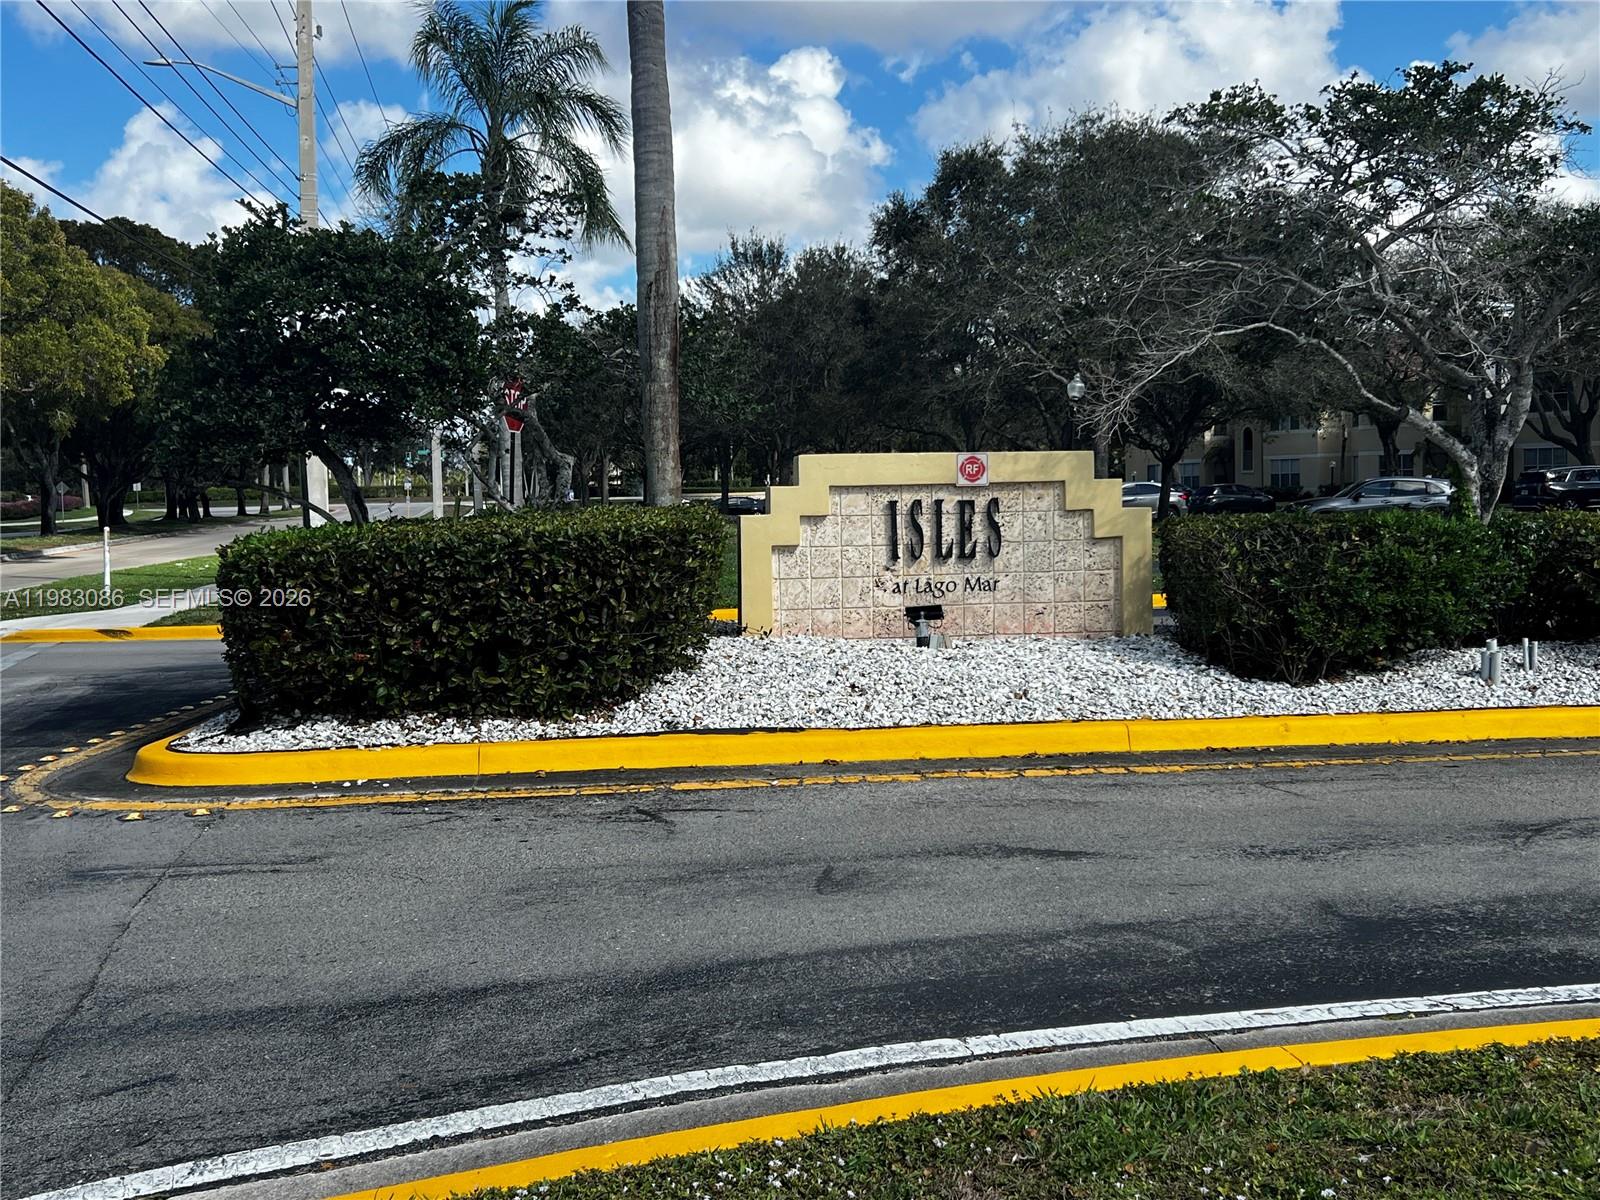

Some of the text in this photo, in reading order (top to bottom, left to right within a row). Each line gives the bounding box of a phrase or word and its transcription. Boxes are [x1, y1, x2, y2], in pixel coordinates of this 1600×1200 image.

[965, 464, 979, 475] RF
[886, 497, 1002, 561] ISLES
[892, 576, 1001, 599] at Lago Mar
